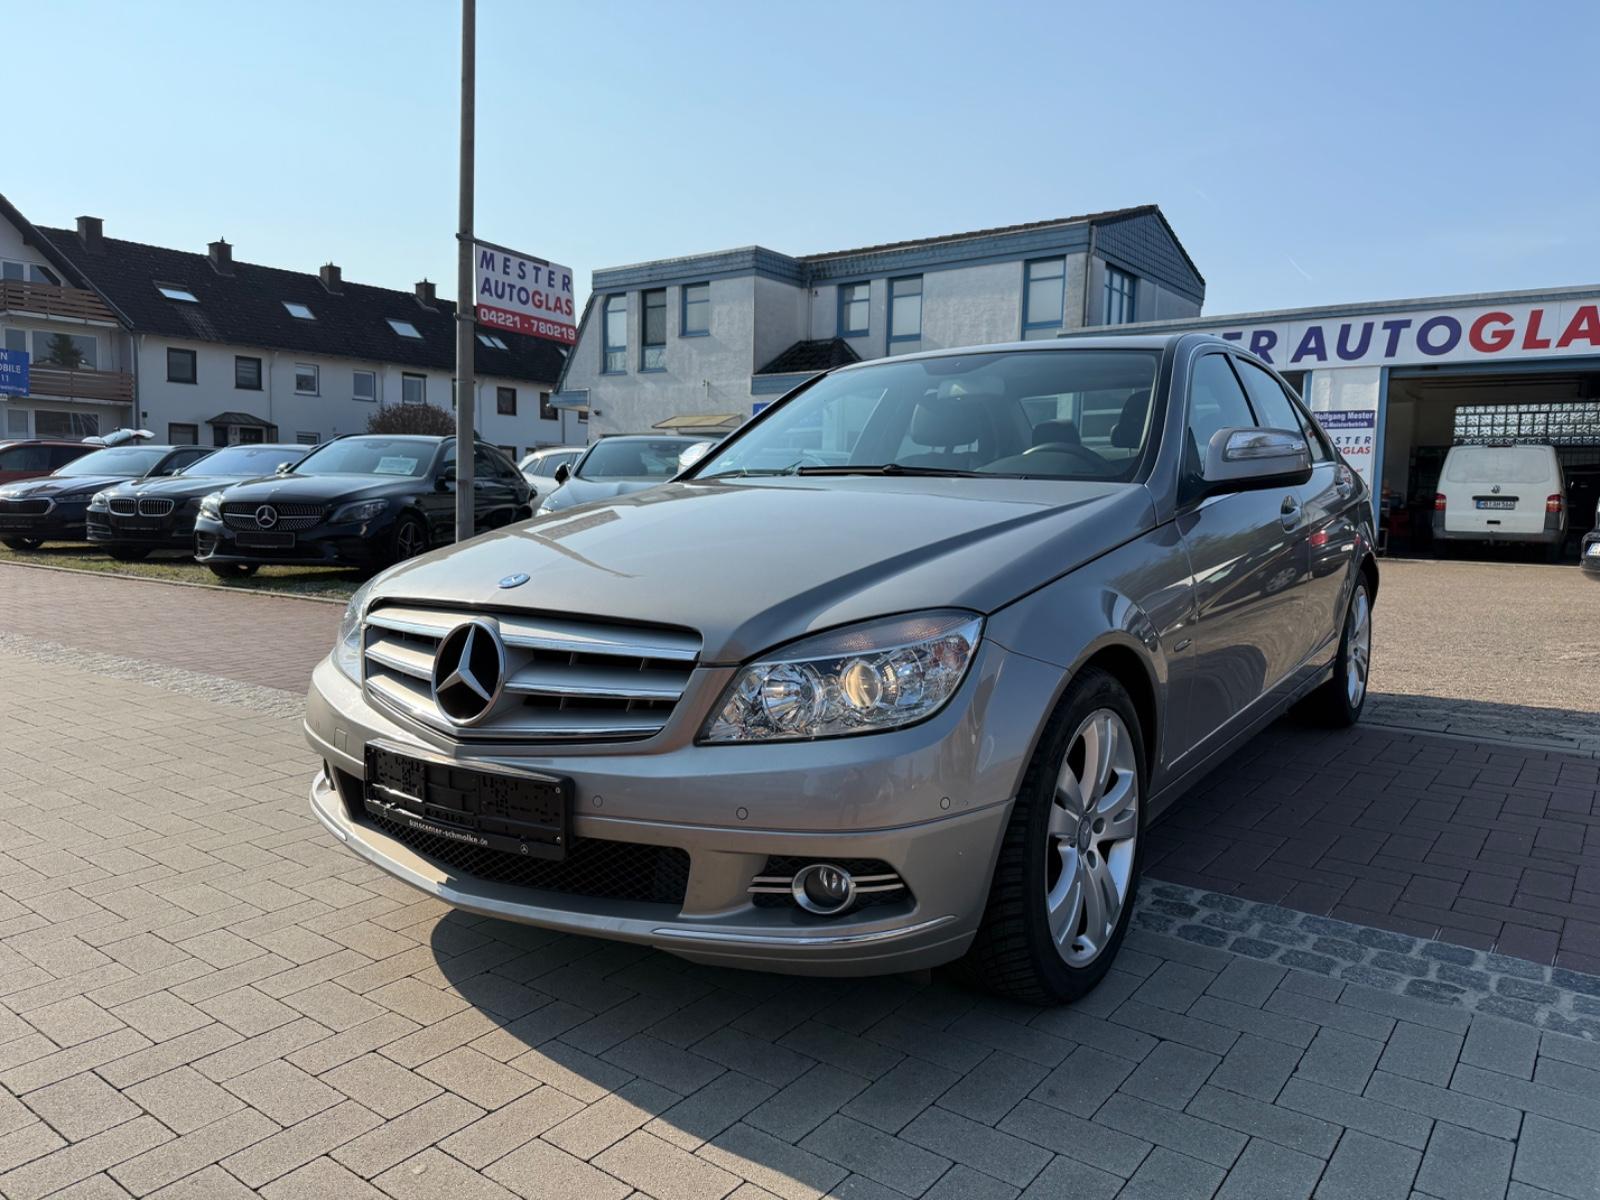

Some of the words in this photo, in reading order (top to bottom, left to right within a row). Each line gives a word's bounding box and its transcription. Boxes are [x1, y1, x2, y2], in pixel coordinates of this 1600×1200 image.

[480, 250, 571, 293] MESTER
[480, 277, 573, 317] AUTOGLAS
[480, 308, 521, 329] 04221
[530, 320, 576, 340] 780219
[1290, 305, 1600, 364] AUTOGLA
[1347, 411, 1373, 420] Mester
